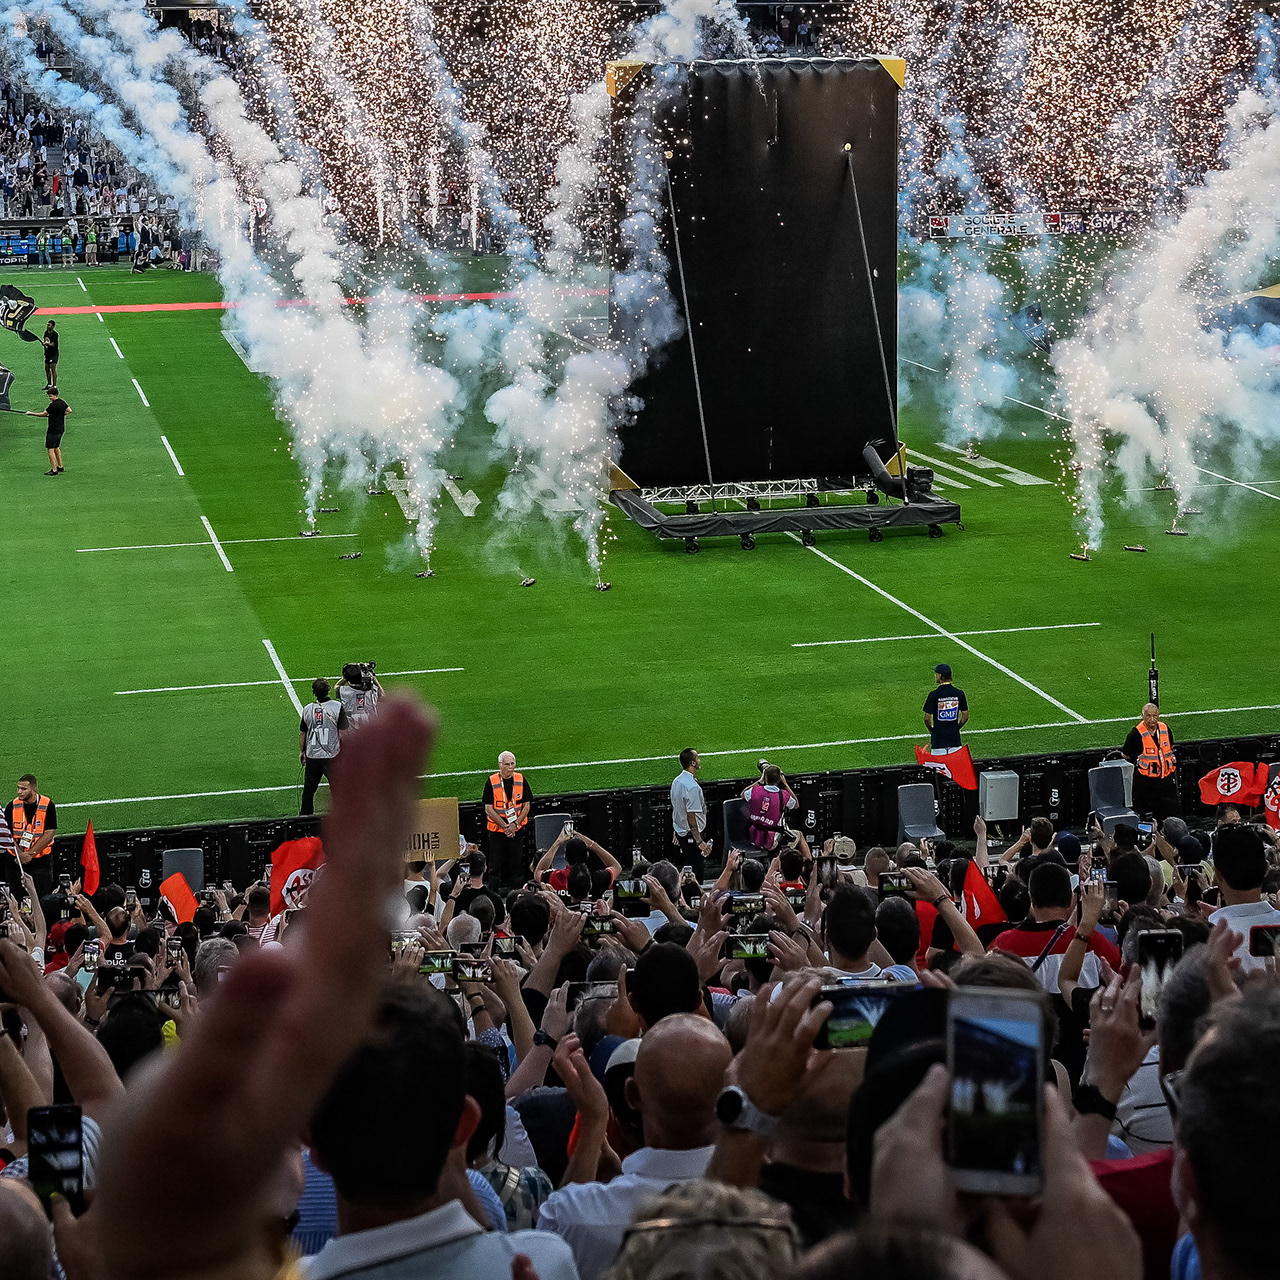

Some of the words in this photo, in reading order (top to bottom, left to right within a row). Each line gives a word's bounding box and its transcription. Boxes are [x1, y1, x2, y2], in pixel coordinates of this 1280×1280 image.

[0, 256, 29, 264] TOP14
[939, 710, 957, 719] GMF
[807, 809, 816, 824] TGI
[142, 869, 151, 886] TGI
